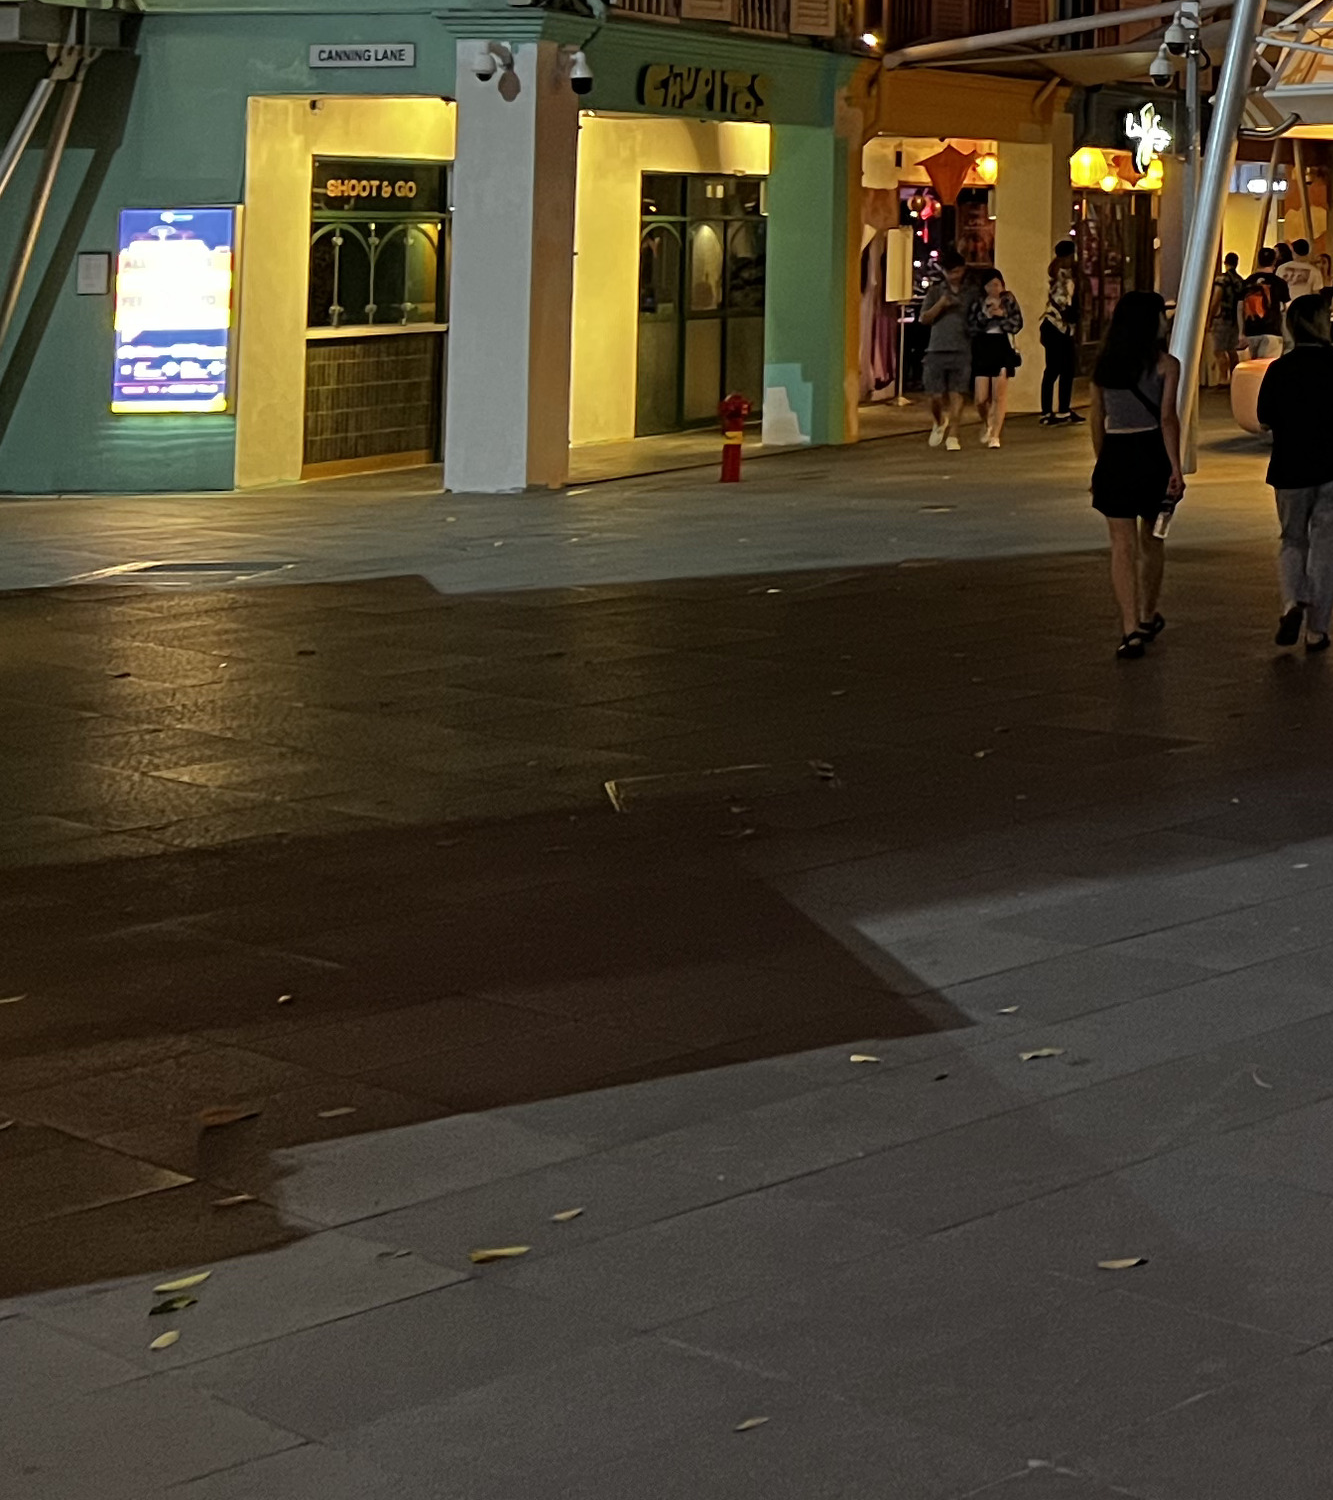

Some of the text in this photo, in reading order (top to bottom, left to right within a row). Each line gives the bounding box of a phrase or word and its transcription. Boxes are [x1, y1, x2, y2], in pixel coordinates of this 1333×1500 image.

[318, 49, 406, 62] CANNING LANE
[326, 179, 417, 198] SHOOT & GO
